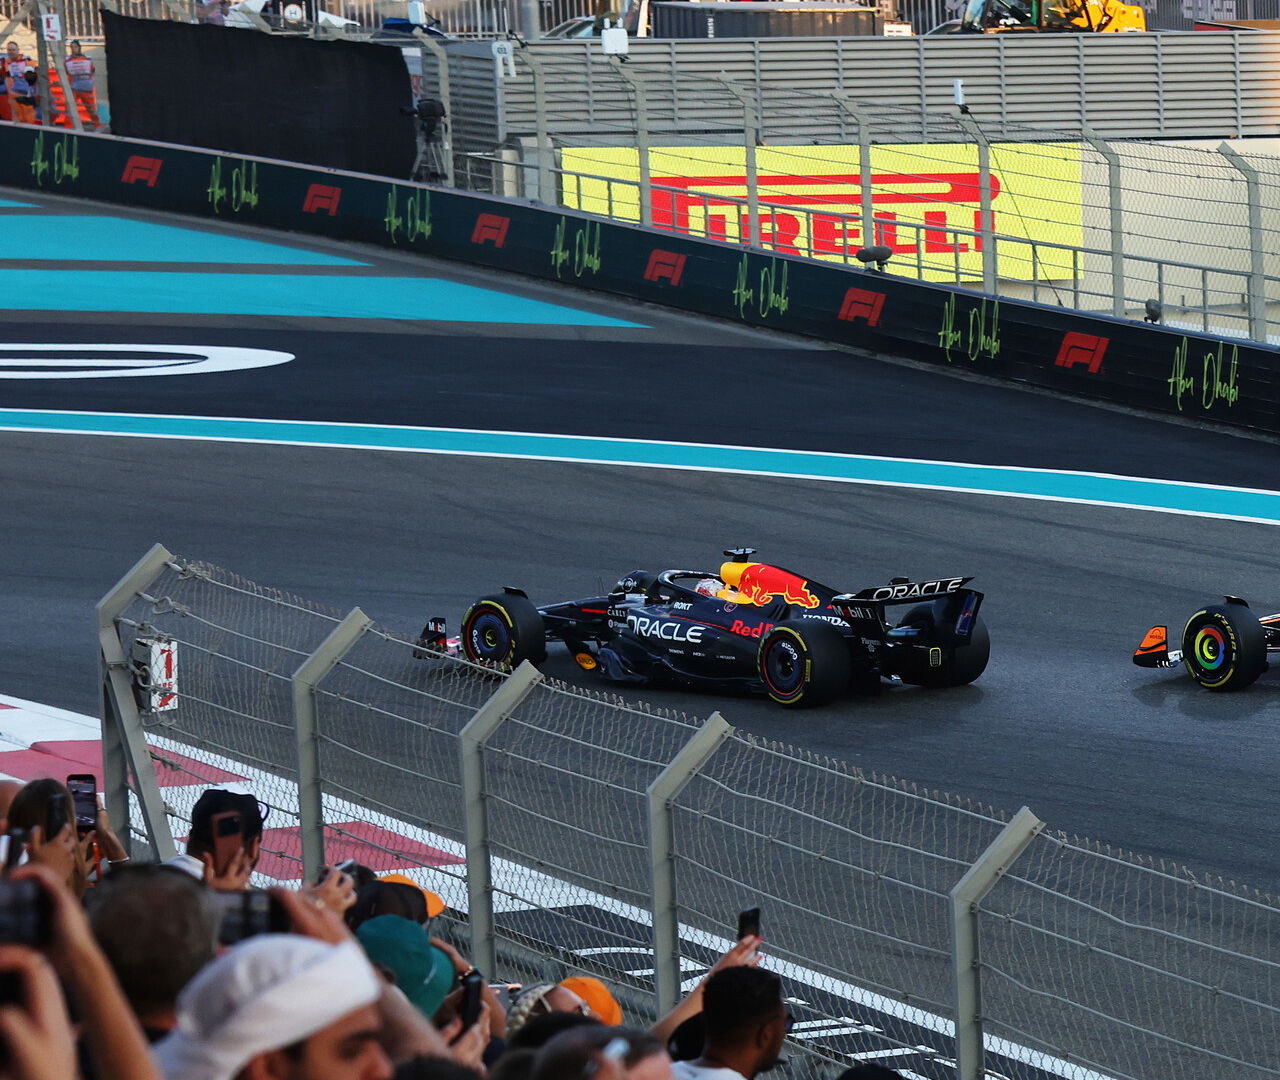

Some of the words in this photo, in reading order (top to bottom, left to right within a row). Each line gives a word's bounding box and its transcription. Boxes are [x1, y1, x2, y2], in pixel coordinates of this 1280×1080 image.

[647, 172, 1000, 257] PIRELLI
[733, 252, 753, 318] Abu
[938, 292, 961, 362] Abu
[969, 297, 1001, 361] Dhabi
[1167, 336, 1194, 411] Abu
[1202, 341, 1240, 410] Dhabi
[832, 606, 863, 620] Mobil
[872, 577, 964, 600] ORACLE
[730, 619, 762, 639] Red
